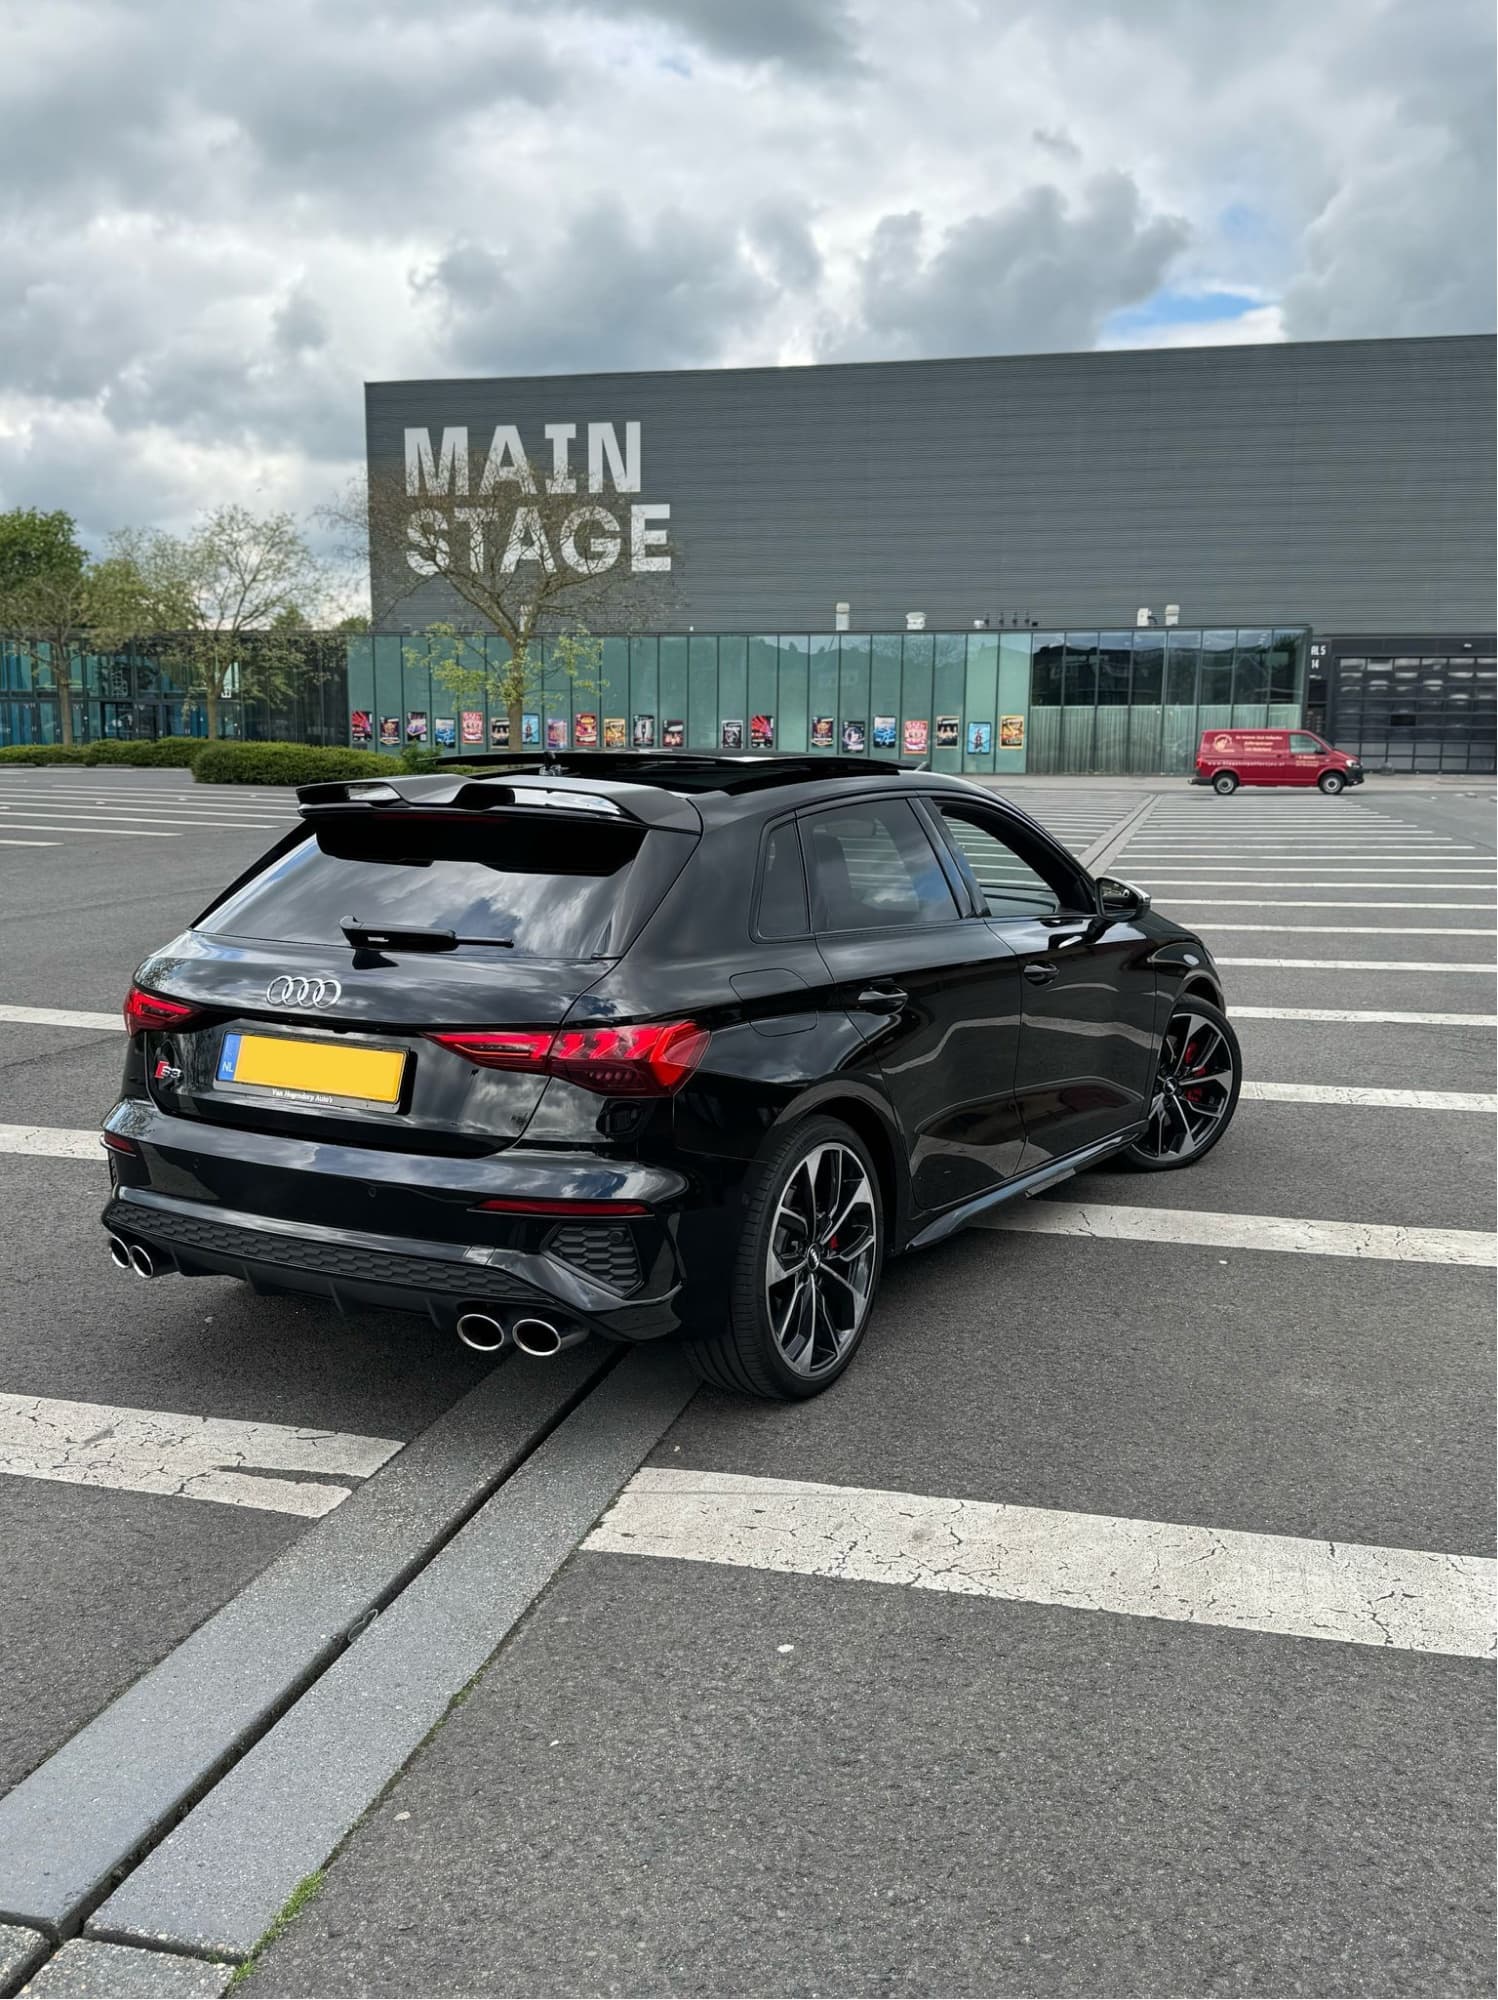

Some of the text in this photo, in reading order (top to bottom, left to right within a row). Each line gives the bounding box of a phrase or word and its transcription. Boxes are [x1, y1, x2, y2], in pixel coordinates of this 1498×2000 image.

[404, 421, 641, 496] MAIN
[405, 503, 672, 576] STAGE
[160, 1064, 182, 1079] S3
[222, 1061, 234, 1073] NL
